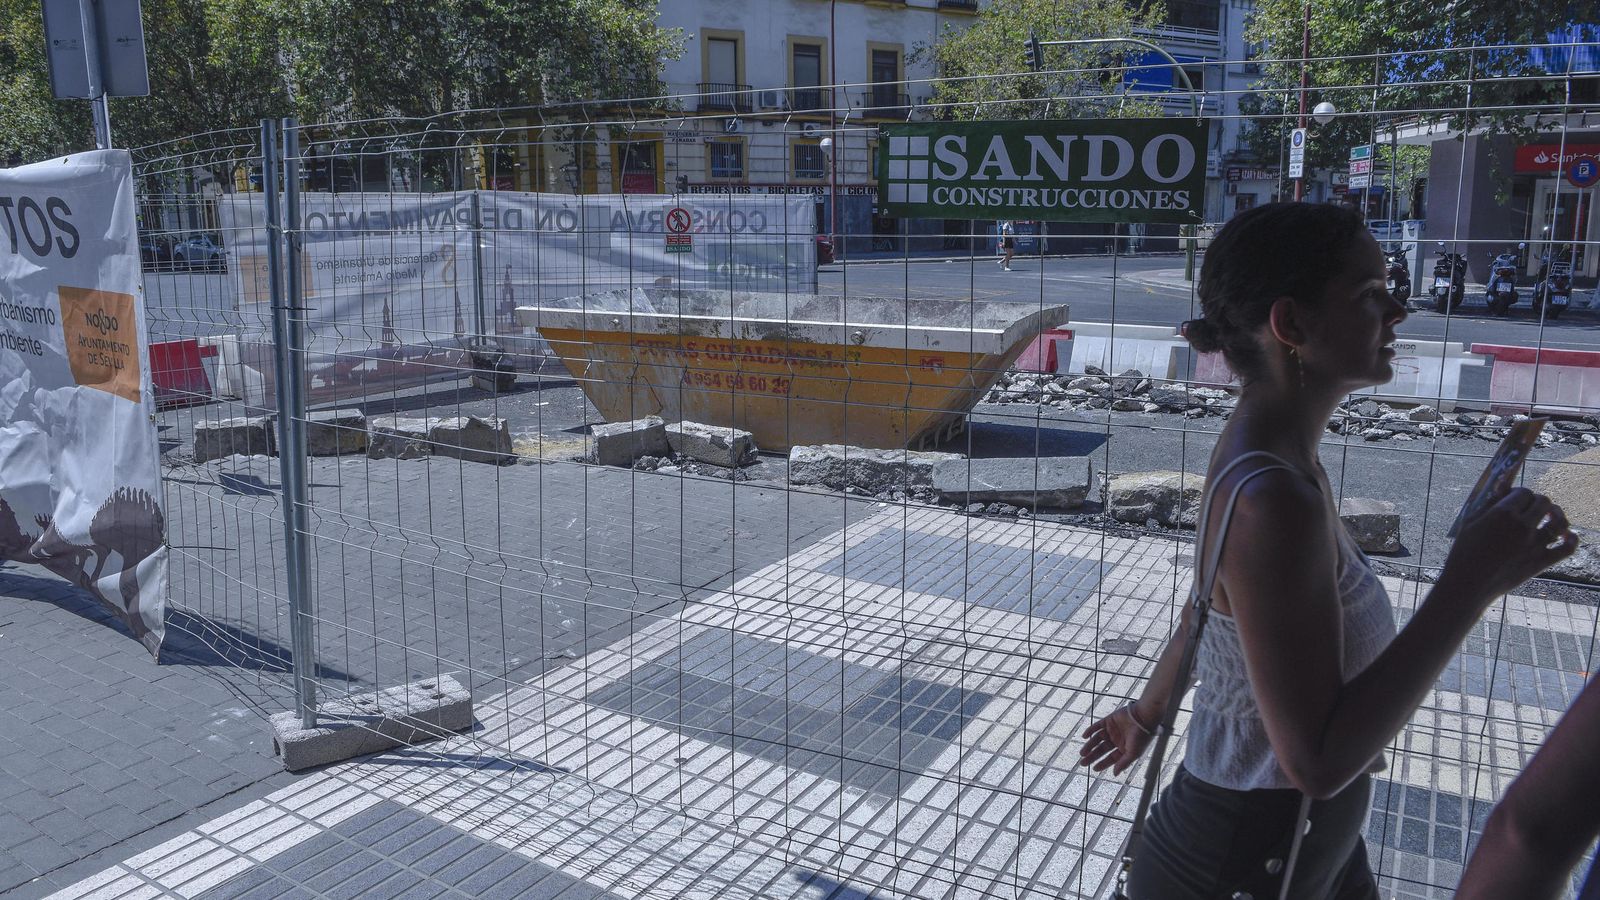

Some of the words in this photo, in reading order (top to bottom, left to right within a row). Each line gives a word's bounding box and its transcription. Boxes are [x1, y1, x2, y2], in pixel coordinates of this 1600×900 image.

[931, 133, 1196, 184] SANDO
[690, 185, 751, 194] REPUESTOS
[768, 185, 825, 195] BICICLETAS
[931, 186, 1191, 211] CONSTRUCCIONES
[0, 195, 81, 259] TOS
[87, 352, 99, 364] DE
